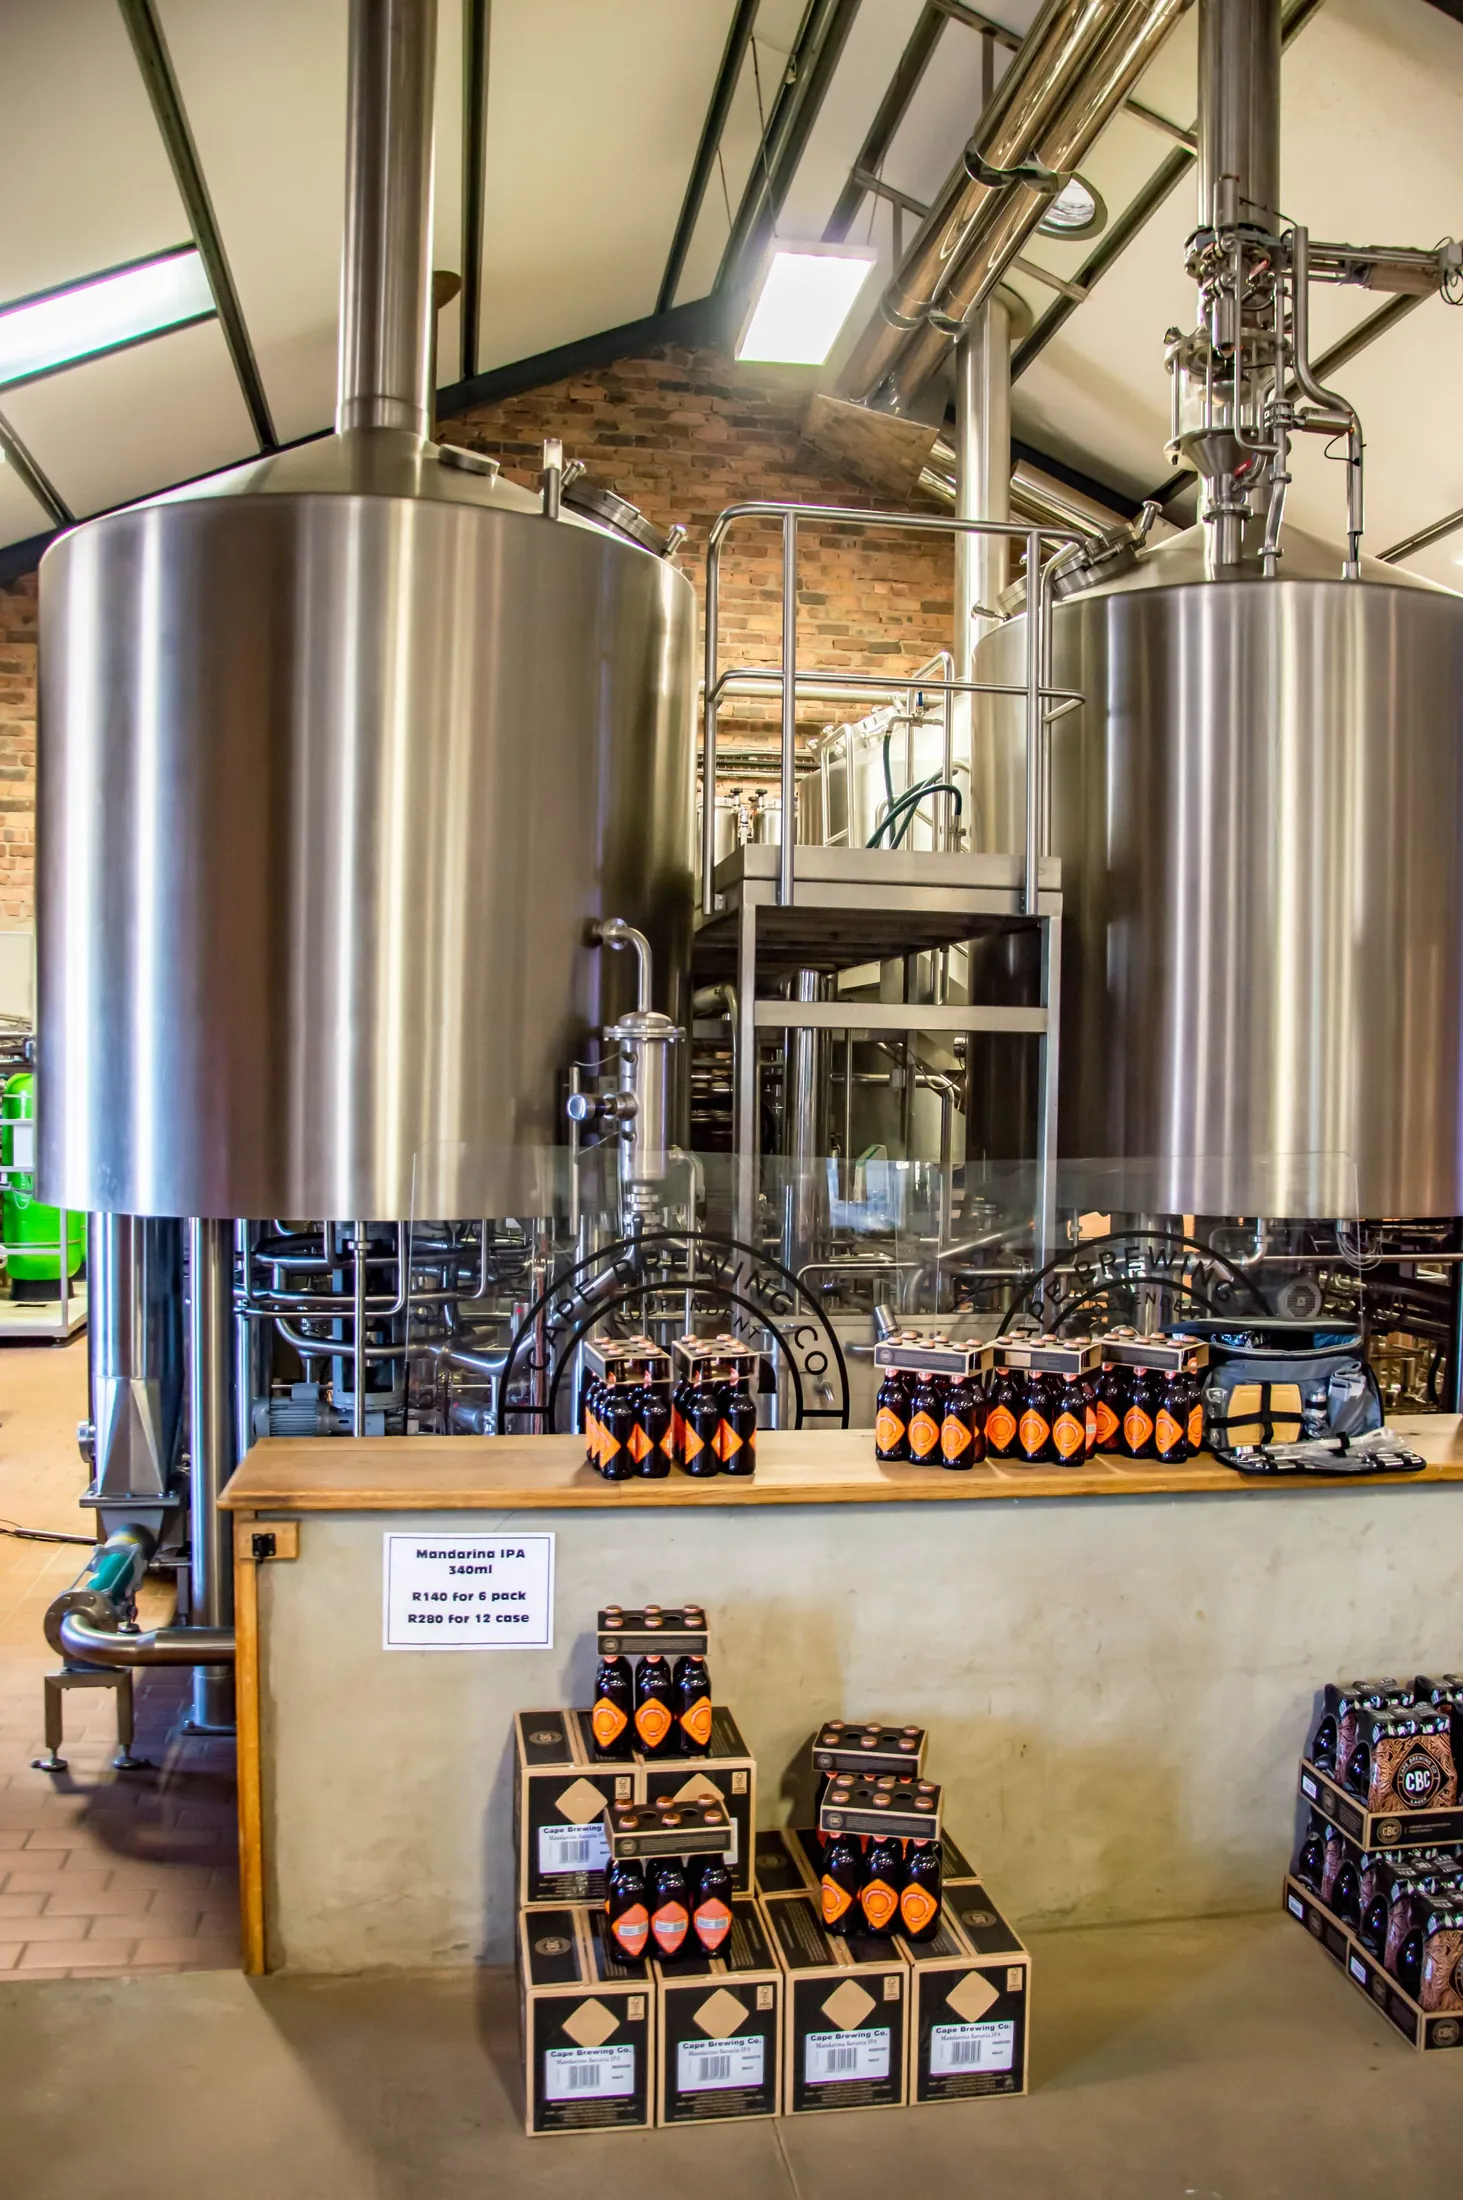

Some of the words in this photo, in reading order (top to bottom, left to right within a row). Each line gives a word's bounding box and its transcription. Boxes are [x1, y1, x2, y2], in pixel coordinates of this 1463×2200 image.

[1074, 1245, 1235, 1301] BREWING
[526, 1277, 601, 1370] CAPE
[612, 1246, 794, 1316] BREWING
[794, 1325, 828, 1376] CO
[416, 1549, 495, 1559] Mandarina
[500, 1549, 525, 1558] IPA
[449, 1565, 492, 1574] 340ml
[412, 1592, 448, 1601] R140
[452, 1592, 474, 1601] for
[478, 1591, 486, 1600] 6
[491, 1591, 526, 1602] pack
[408, 1614, 443, 1623] R280
[448, 1614, 470, 1623] for
[475, 1613, 491, 1623] 12
[495, 1614, 529, 1623] case
[1408, 1755, 1432, 1765] BREWING
[1405, 1770, 1431, 1792] CBC
[1382, 1826, 1397, 1836] CBC
[708, 2039, 744, 2047] Brewing
